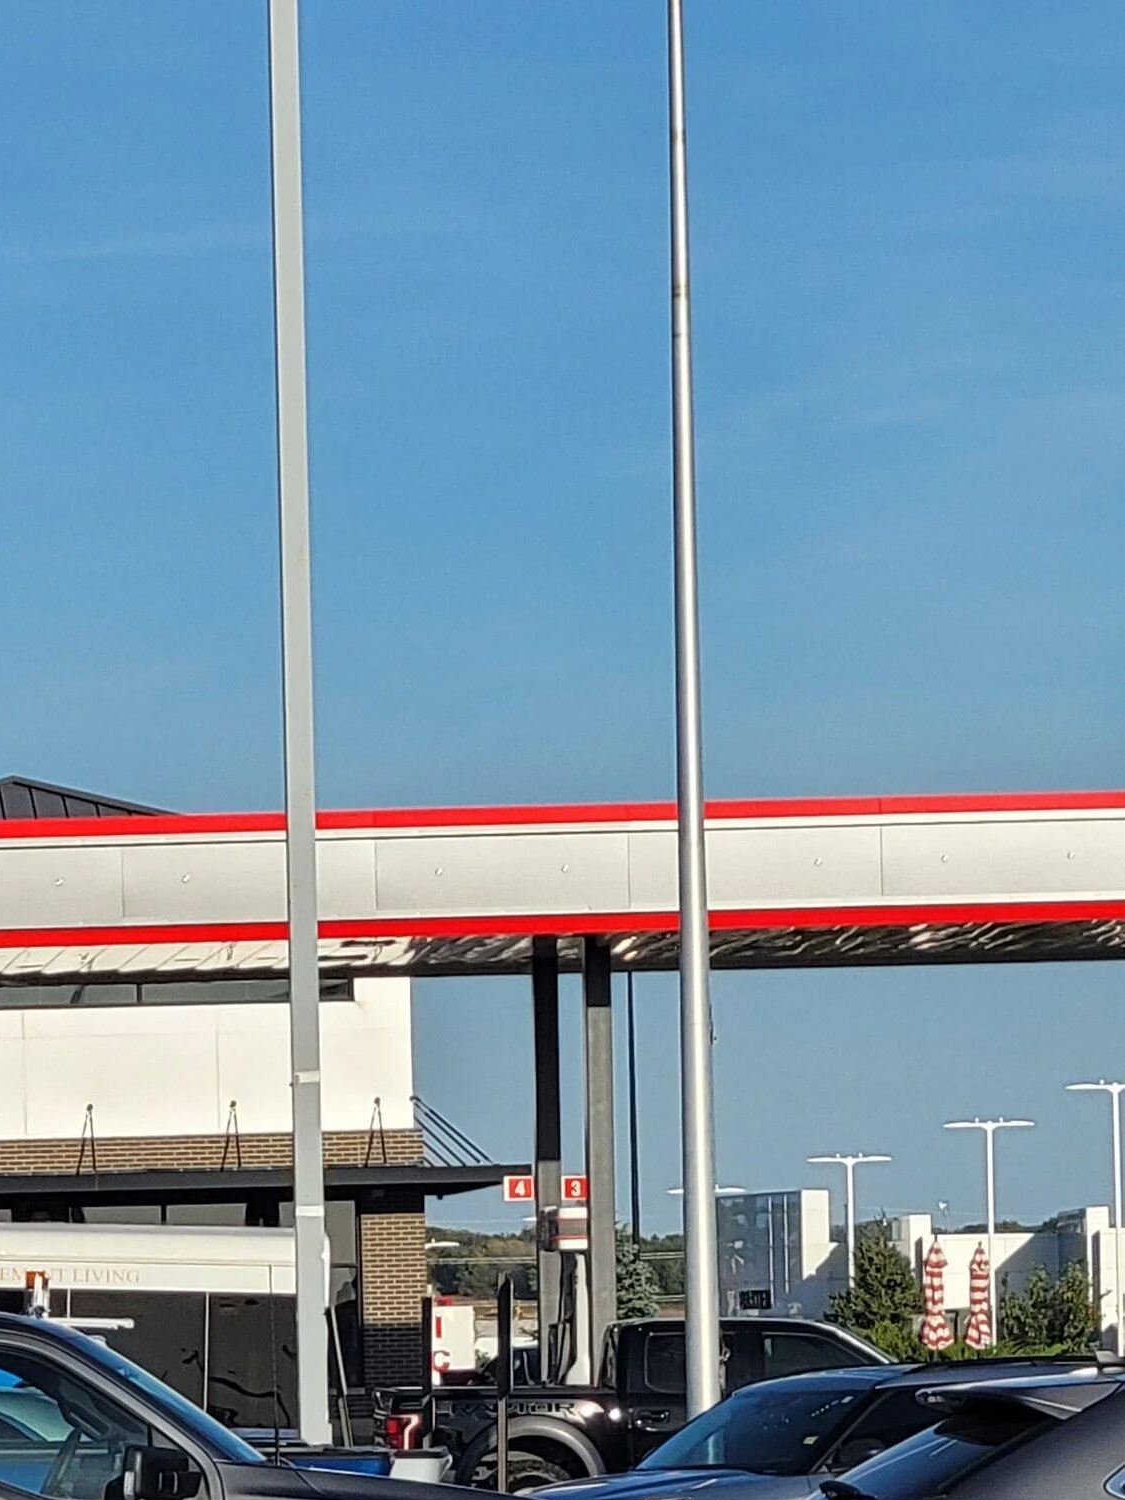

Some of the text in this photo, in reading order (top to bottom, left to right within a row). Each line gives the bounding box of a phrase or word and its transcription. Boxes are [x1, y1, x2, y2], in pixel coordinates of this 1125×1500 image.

[515, 1180, 526, 1196] 4
[570, 1180, 581, 1196] 3
[73, 1268, 140, 1284] LIVING
